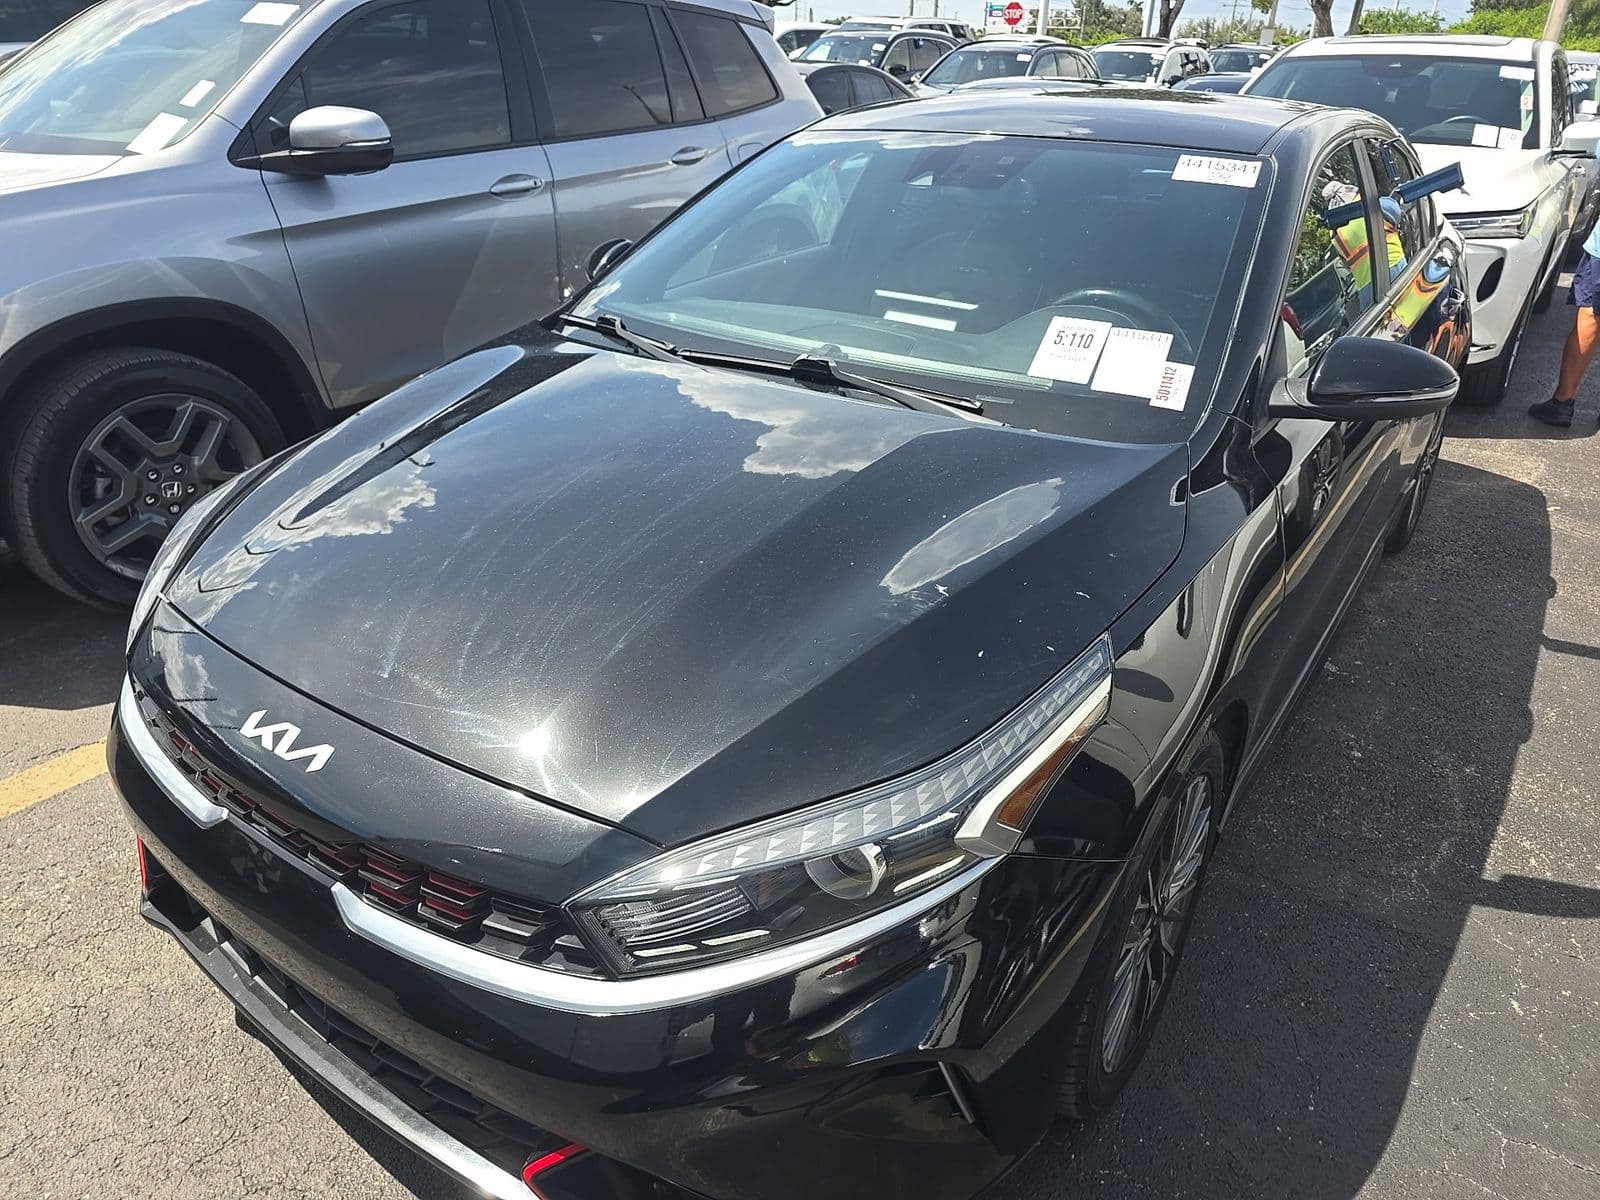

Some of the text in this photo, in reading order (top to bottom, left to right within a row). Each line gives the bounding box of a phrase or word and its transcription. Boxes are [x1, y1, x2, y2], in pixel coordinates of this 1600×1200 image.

[1003, 8, 1023, 19] STOP
[1181, 158, 1258, 174] 4415341
[1053, 330, 1095, 349] 5:110
[1155, 366, 1178, 402] 5011412
